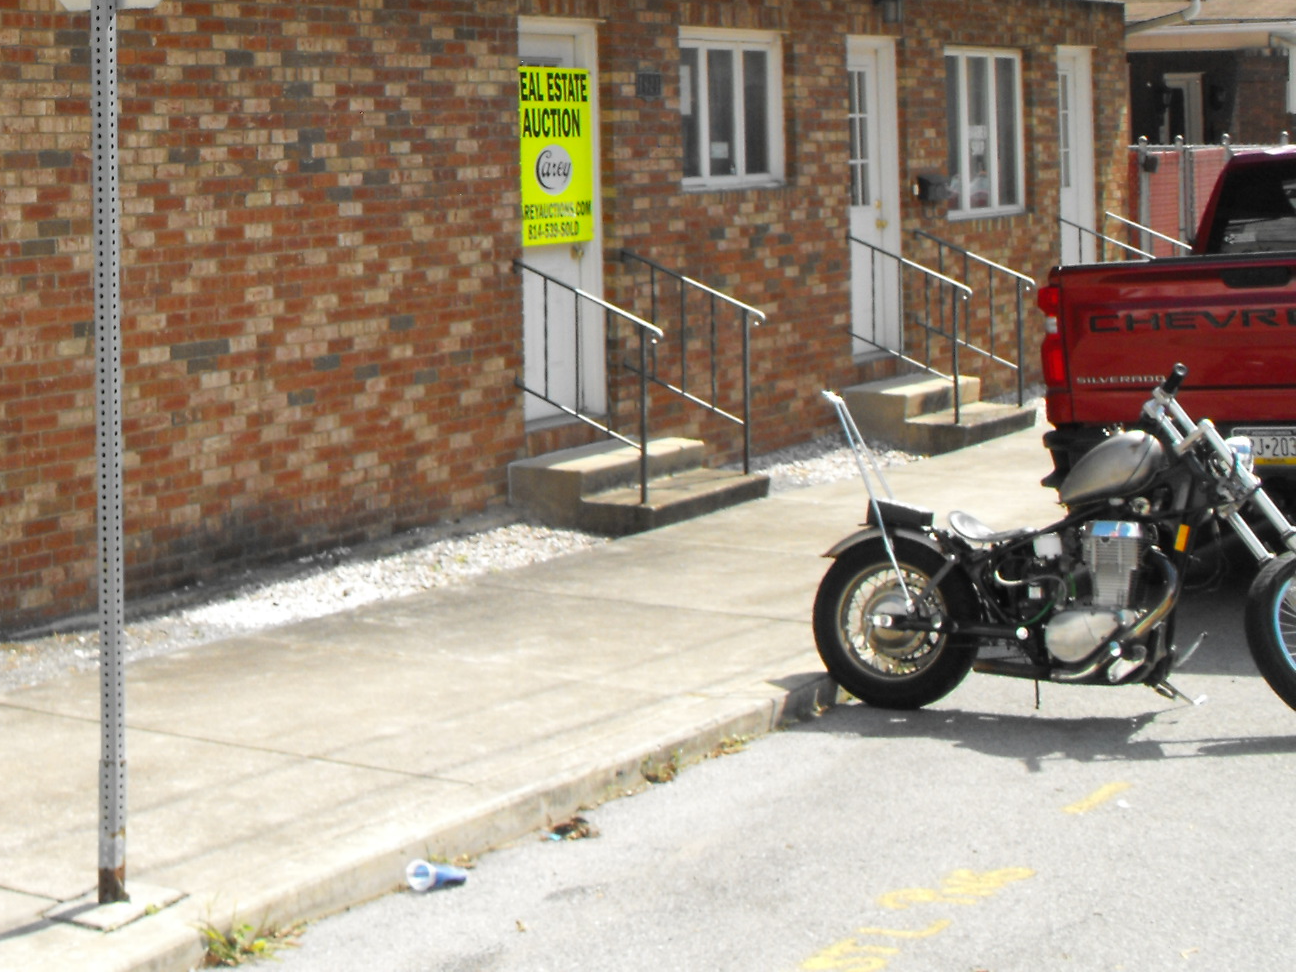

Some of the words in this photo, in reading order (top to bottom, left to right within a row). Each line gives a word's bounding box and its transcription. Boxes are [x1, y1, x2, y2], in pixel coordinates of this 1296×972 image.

[547, 72, 588, 103] ESTATE
[522, 108, 581, 138] AUCTION
[1076, 375, 1167, 385] SILVERADO
